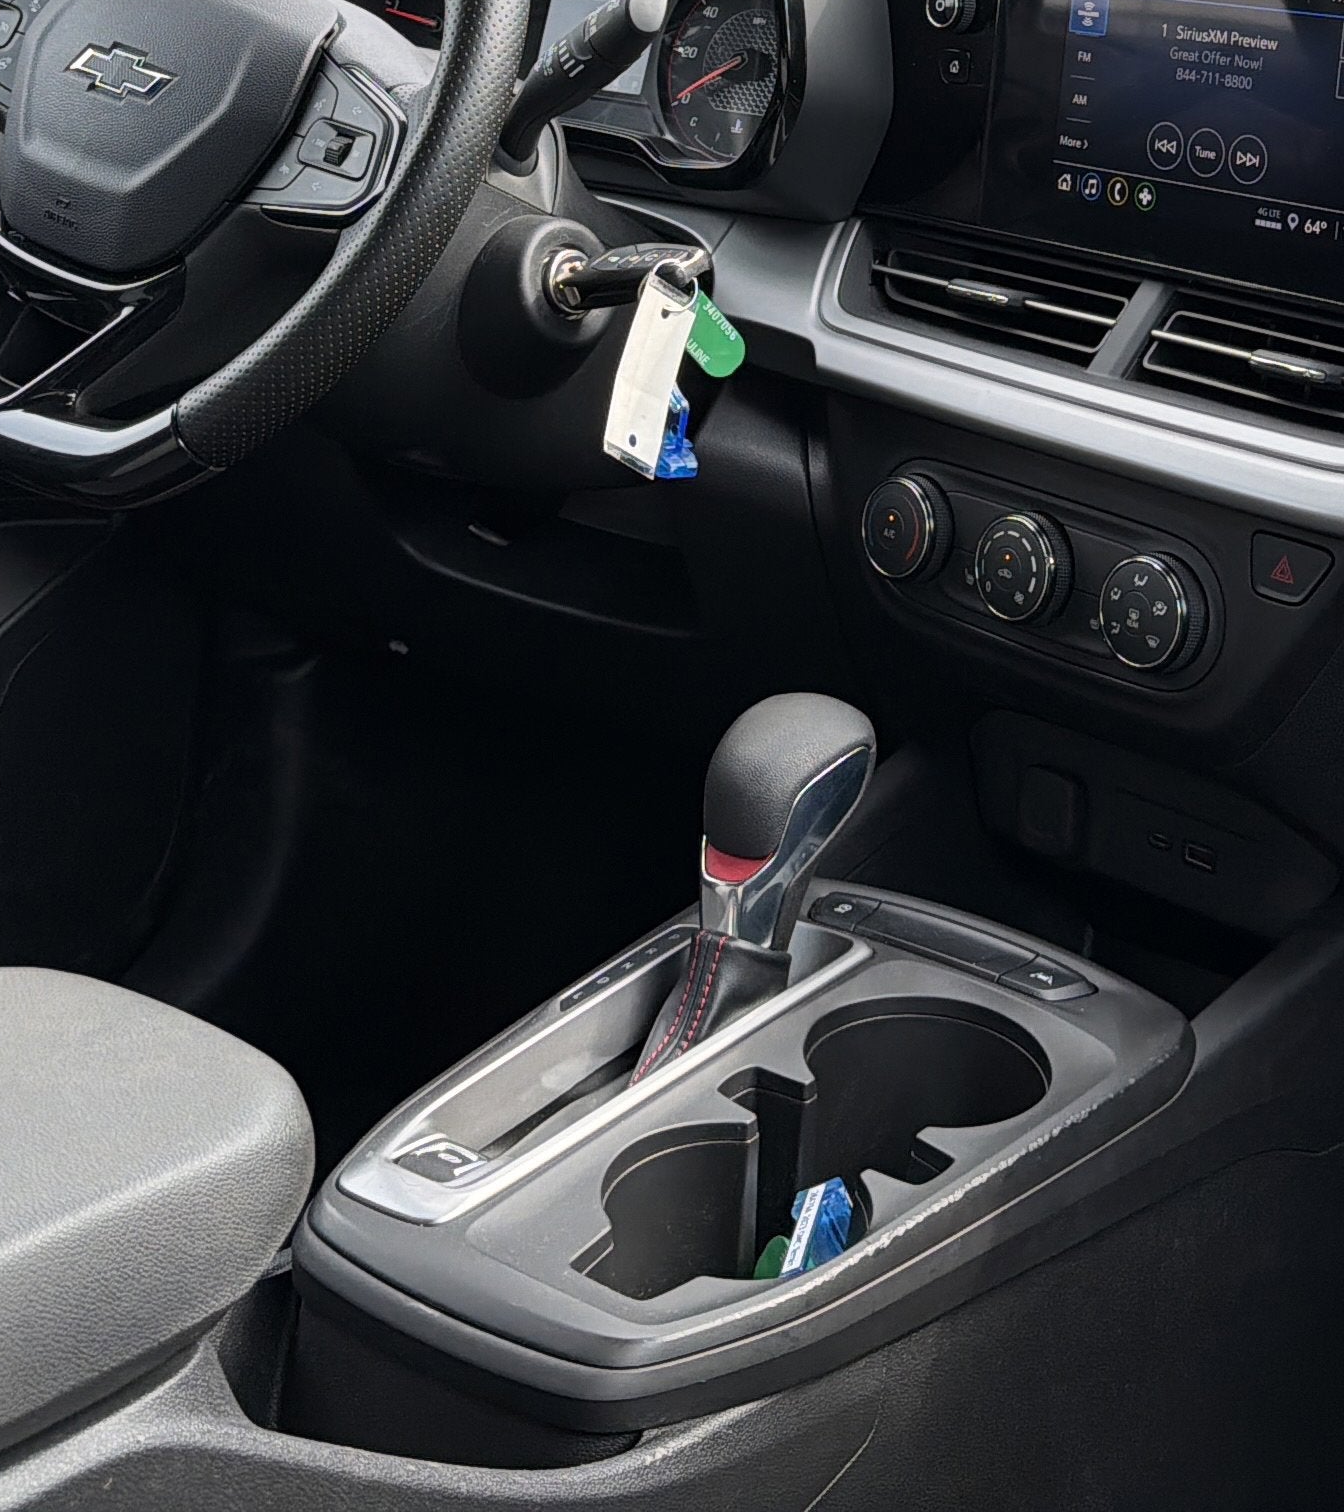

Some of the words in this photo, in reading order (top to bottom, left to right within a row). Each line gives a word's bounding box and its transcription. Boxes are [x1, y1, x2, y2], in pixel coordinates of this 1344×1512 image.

[702, 5, 719, 19] 40
[1161, 23, 1168, 38] 1
[1175, 25, 1228, 45] SiriusXM
[1230, 30, 1279, 50] Preview
[681, 46, 698, 59] 20
[1077, 50, 1092, 64] FM
[1169, 47, 1198, 62] Great
[1200, 49, 1230, 66] Offer
[1232, 53, 1264, 70] Now!
[1175, 67, 1253, 90] 844-711-8800
[1072, 93, 1088, 107] AM
[689, 117, 698, 128] C
[1059, 135, 1083, 150] More
[1194, 146, 1217, 161] Tune
[1268, 210, 1282, 219] LTE
[702, 302, 737, 341] 3407056
[882, 526, 897, 540] A/C
